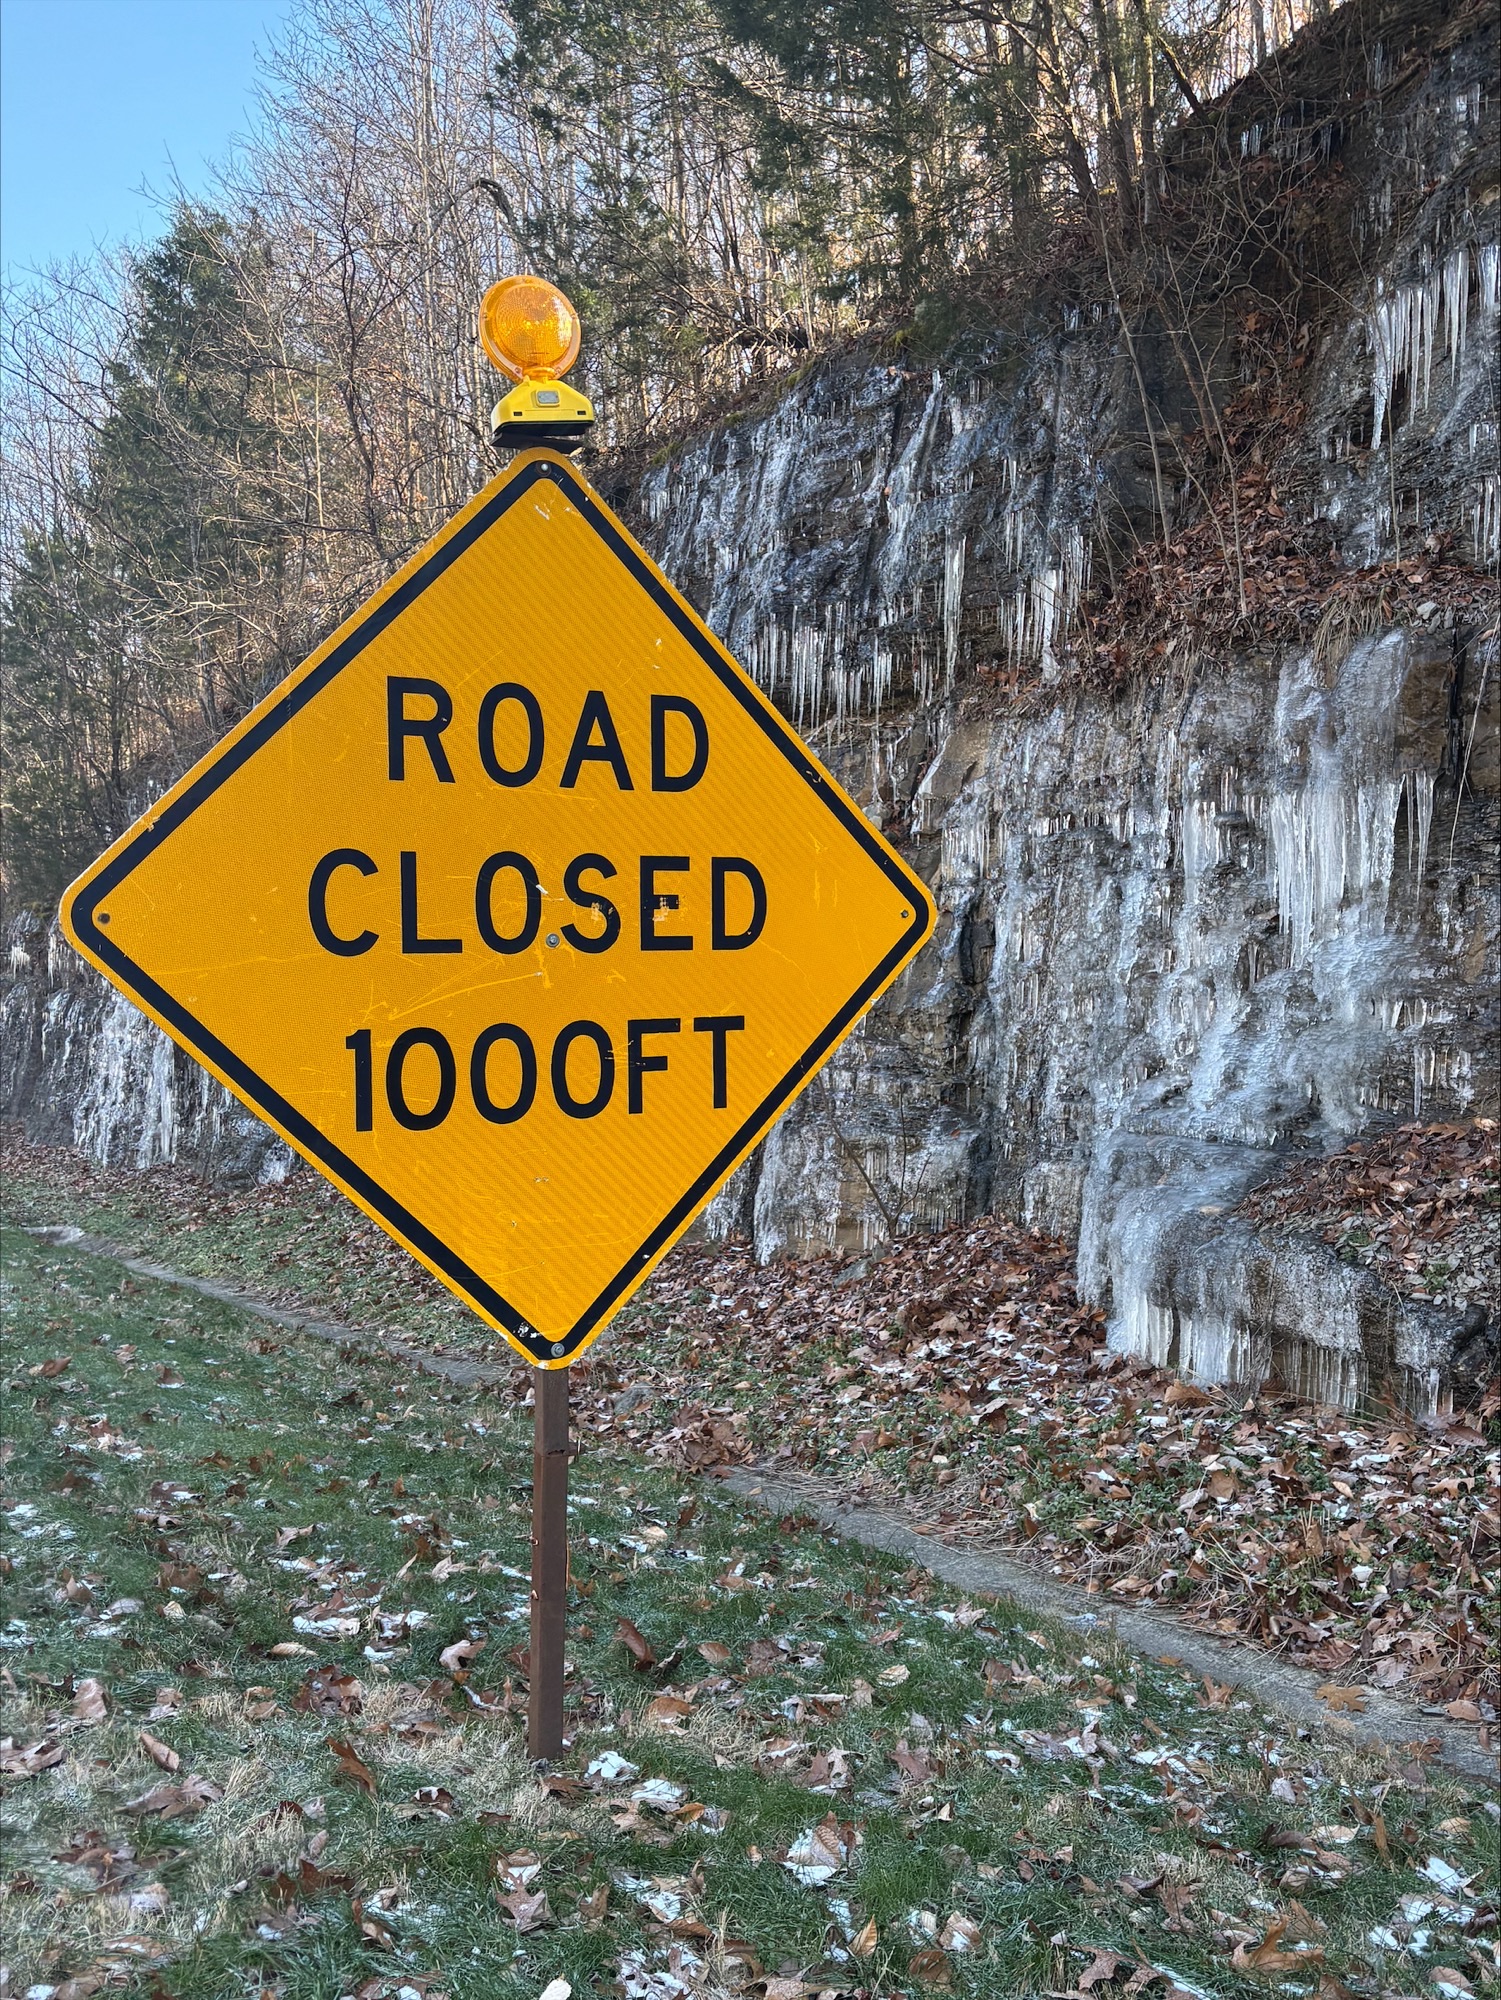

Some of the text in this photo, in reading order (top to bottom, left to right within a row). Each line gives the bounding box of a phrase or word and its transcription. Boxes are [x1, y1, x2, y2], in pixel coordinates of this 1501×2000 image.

[387, 675, 709, 793] ROAD
[308, 848, 768, 957] CLOSED
[345, 1015, 745, 1132] 1000FT
